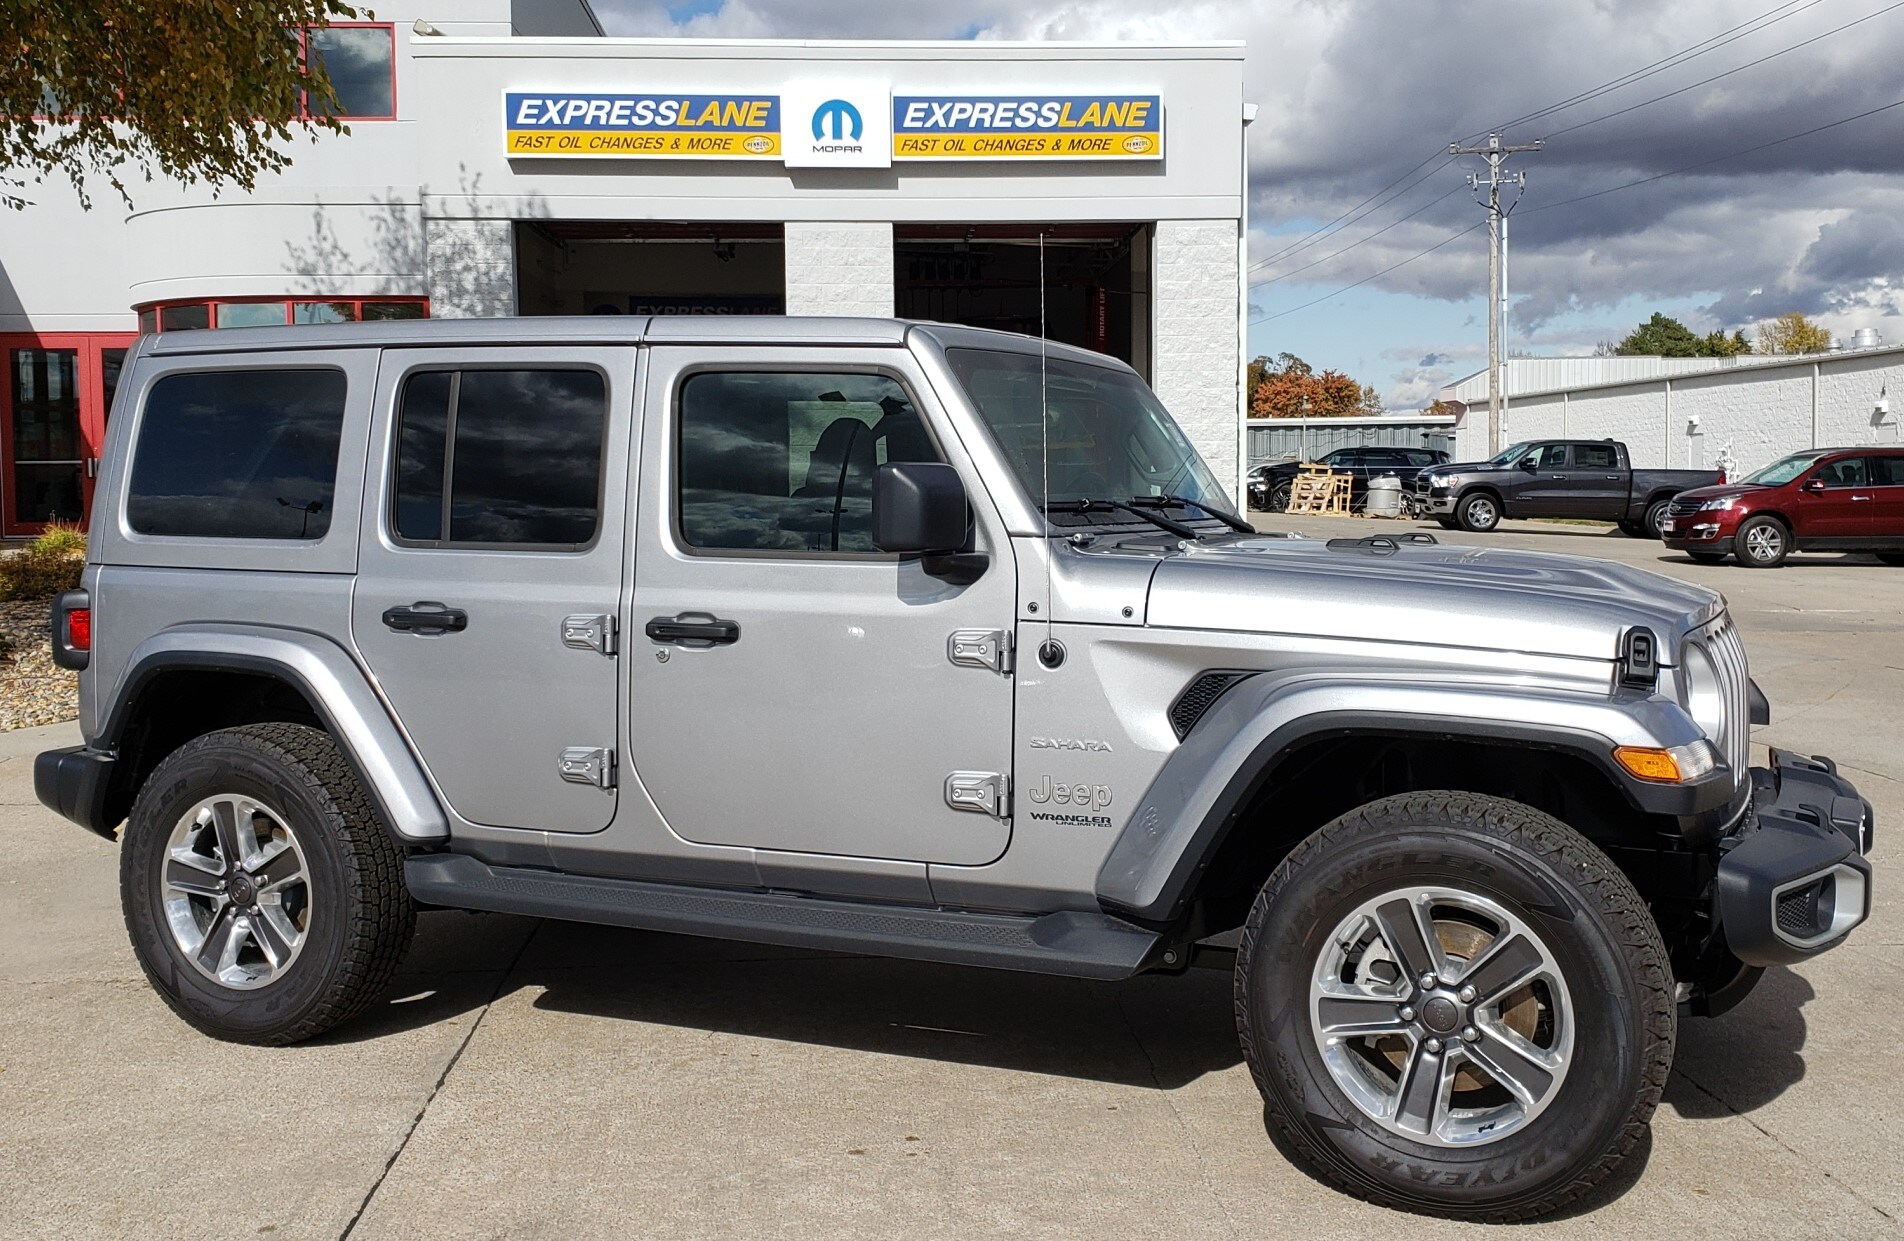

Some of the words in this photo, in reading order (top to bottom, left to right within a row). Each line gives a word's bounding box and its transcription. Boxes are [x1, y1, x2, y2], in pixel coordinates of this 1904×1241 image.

[516, 98, 772, 127] EXPRESSLANE
[902, 101, 1151, 128] EXPRESSLANE
[514, 136, 555, 149] FAST
[558, 137, 582, 149] OIL
[589, 137, 665, 150] CHANGES
[670, 138, 681, 150] &
[686, 138, 734, 150] MORE
[812, 145, 863, 154] MOPAR
[901, 139, 940, 151] FAST
[943, 139, 966, 151] OIL
[973, 139, 1046, 152] CHANGES
[1051, 139, 1062, 151] &
[1067, 138, 1113, 151] MORE
[1030, 736, 1113, 752] SAHARA
[1029, 775, 1112, 811] Jeep
[1030, 812, 1111, 824] WRANGLER
